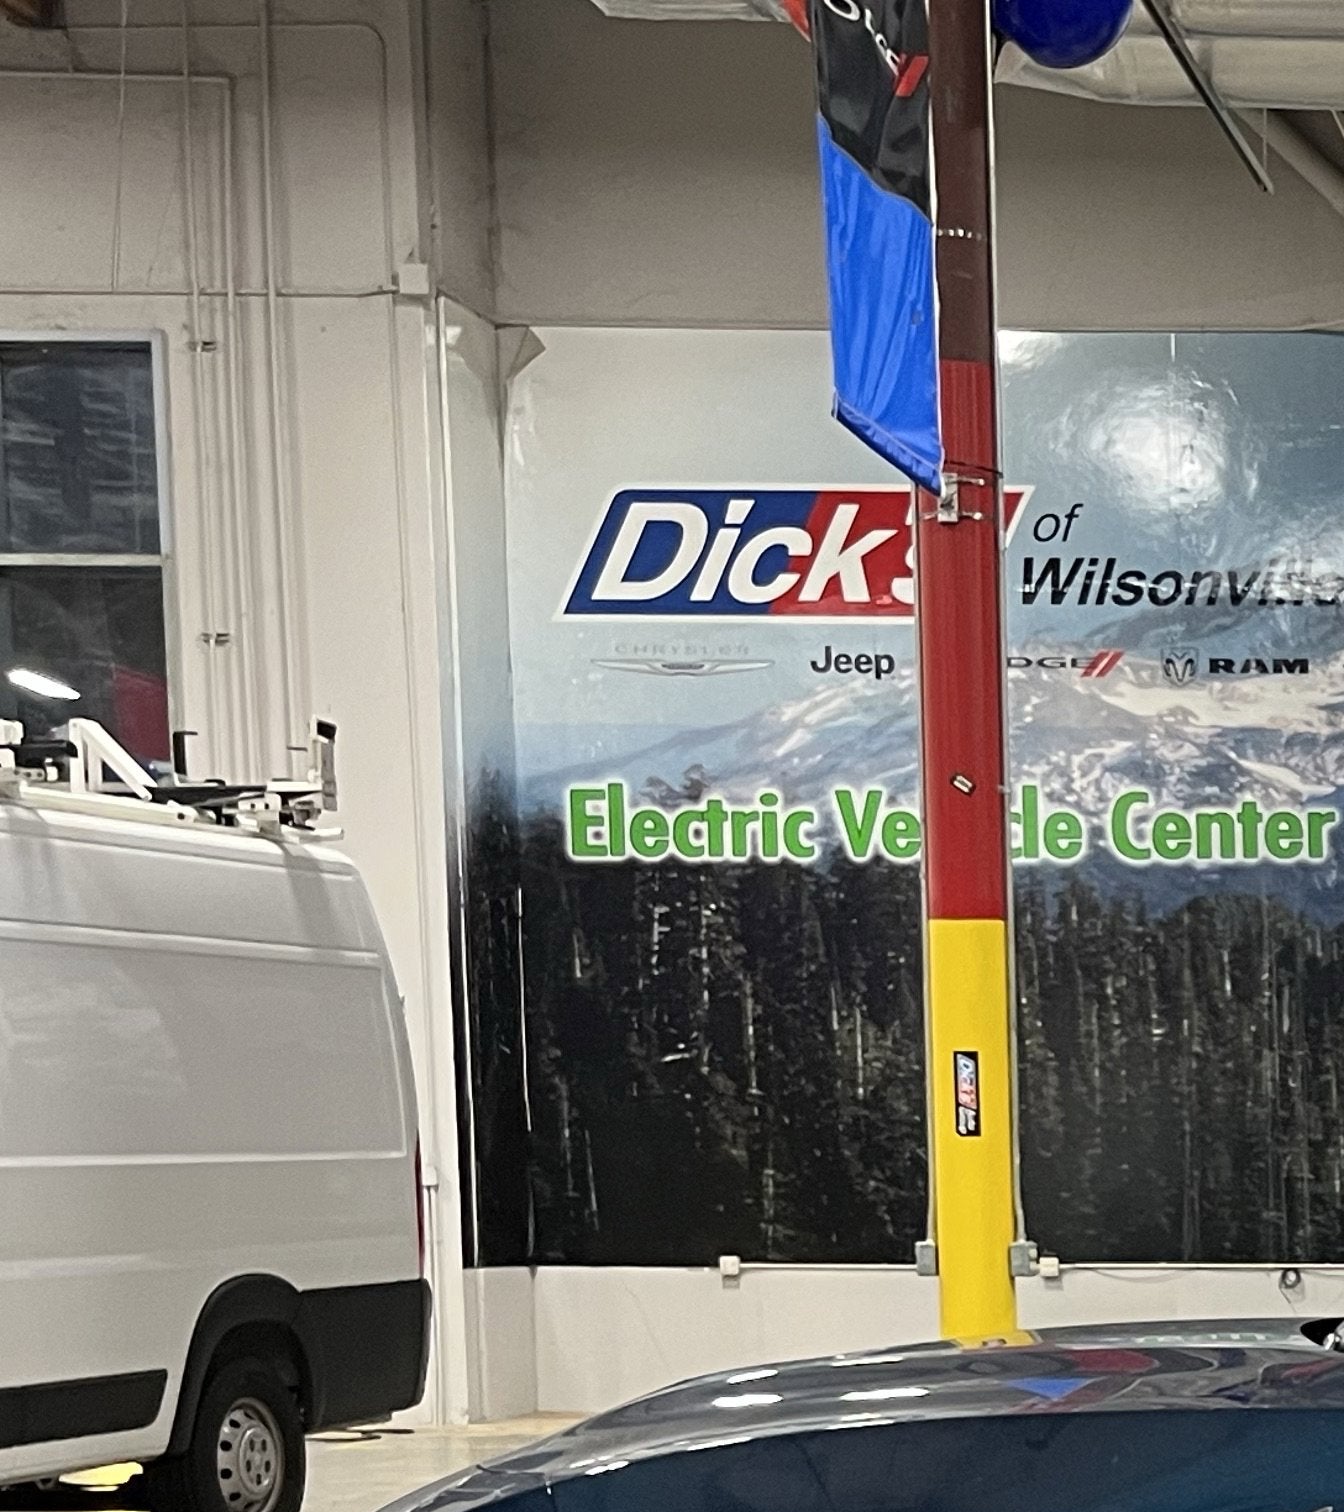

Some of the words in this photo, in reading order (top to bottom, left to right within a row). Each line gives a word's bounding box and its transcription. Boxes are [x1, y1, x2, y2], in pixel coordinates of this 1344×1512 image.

[1032, 503, 1084, 543] of
[591, 499, 914, 605] Dick
[810, 645, 895, 680] Jeep
[1006, 655, 1094, 669] DGE
[1209, 657, 1310, 674] RAM
[570, 782, 816, 858] Electric
[834, 784, 1083, 860] Vele
[1111, 790, 1336, 860] Center
